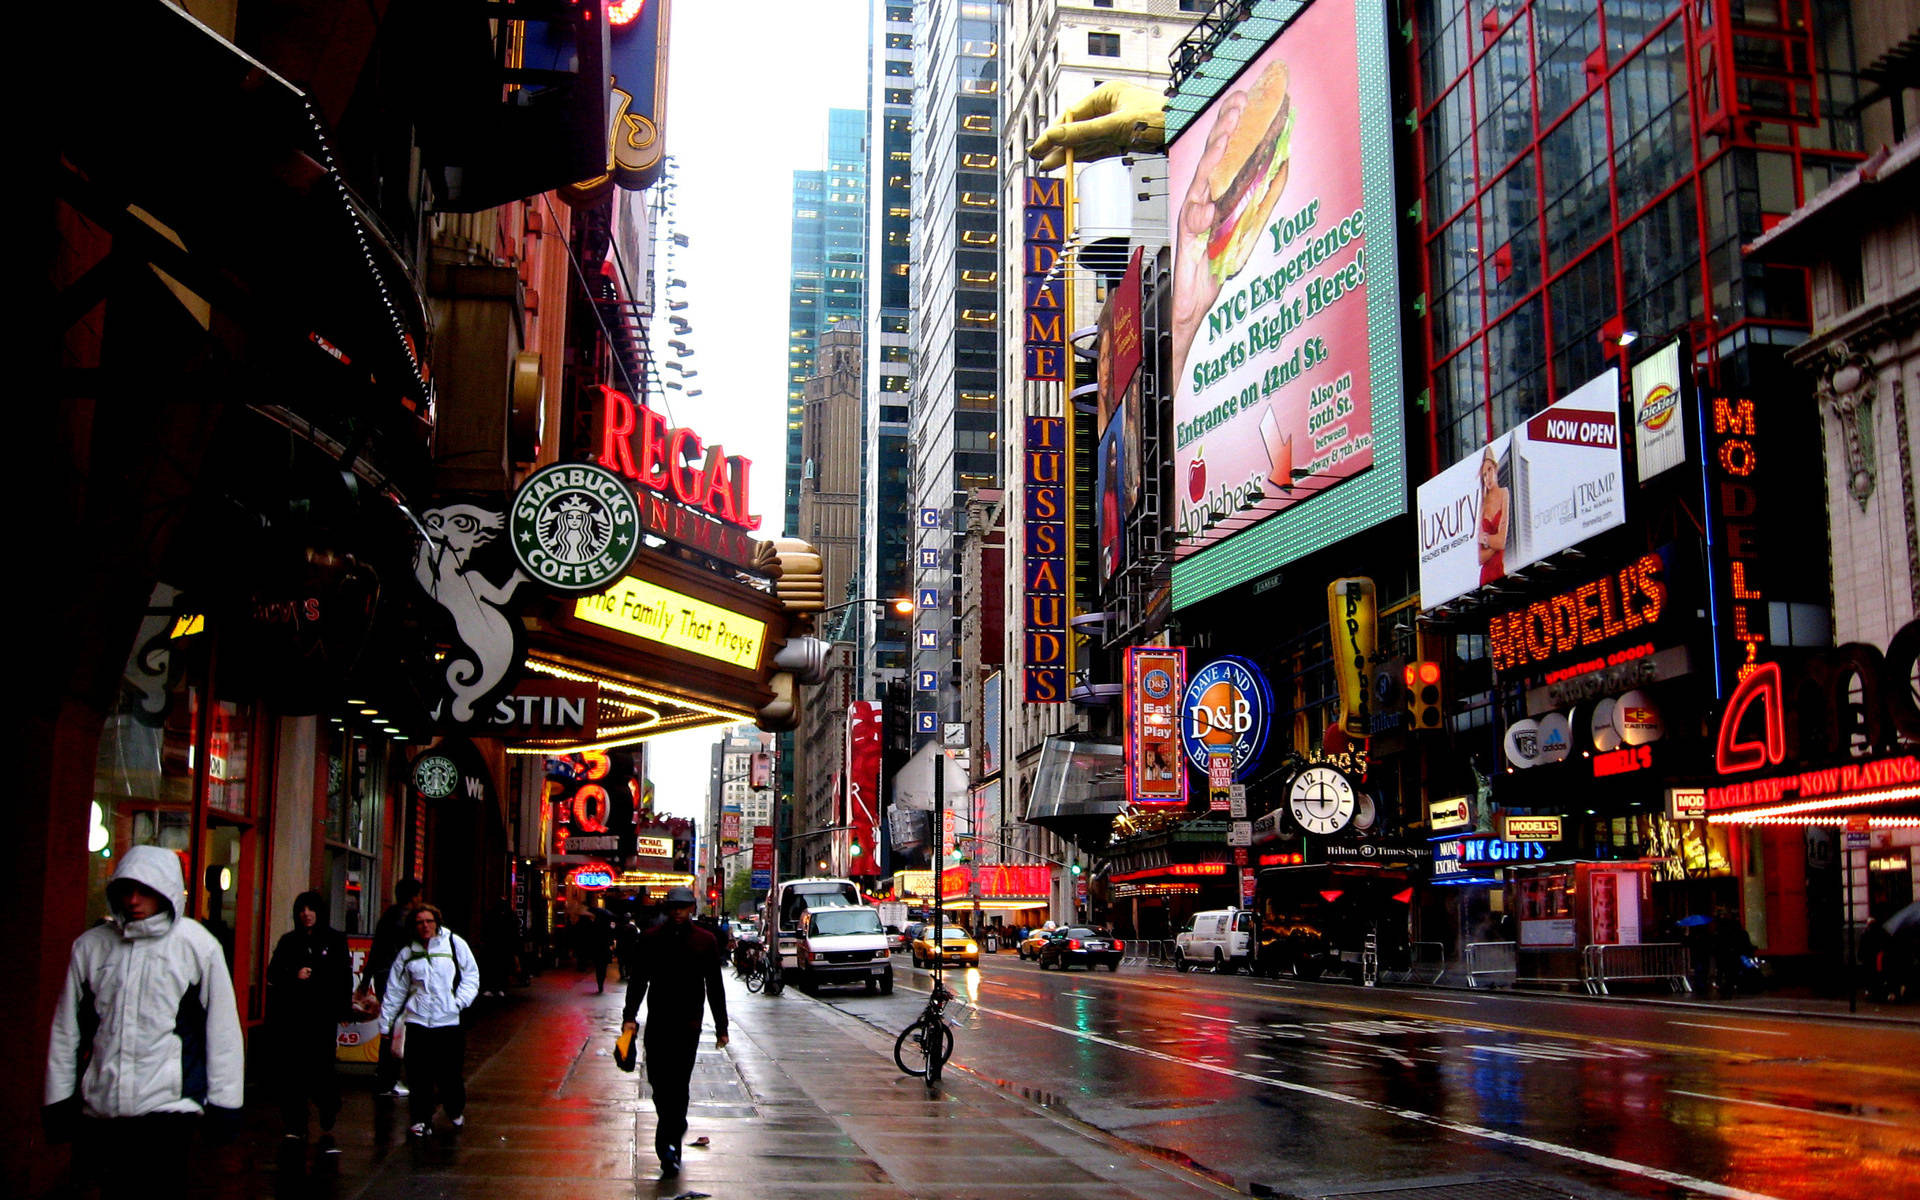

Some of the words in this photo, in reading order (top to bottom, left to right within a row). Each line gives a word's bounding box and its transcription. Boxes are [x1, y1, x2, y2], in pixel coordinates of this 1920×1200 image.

[1269, 197, 1320, 257] Your
[1028, 178, 1062, 377] MADAME
[1207, 289, 1247, 344] NYC
[1250, 208, 1366, 314] Experience
[1191, 334, 1246, 395] Starts
[1248, 301, 1303, 358] Right
[1304, 248, 1366, 318] Here!
[1176, 395, 1239, 451] Entrance
[1239, 385, 1259, 411] on
[1260, 350, 1301, 399] 42nd
[1303, 335, 1329, 371] St.
[1308, 384, 1334, 411] Also
[1334, 374, 1352, 396] on
[1641, 394, 1677, 419] Dickies
[1307, 406, 1334, 435] 50th
[1335, 395, 1354, 422] St.
[1315, 426, 1347, 450] between
[1546, 418, 1578, 441] NOW
[1579, 421, 1615, 446] OPEN
[598, 383, 763, 532] REGAL
[1307, 454, 1330, 475] dway
[1331, 447, 1340, 463] &
[1339, 443, 1354, 460] 7th
[1354, 434, 1372, 452] Ave.
[518, 468, 633, 526] STARBUCKS
[1577, 471, 1616, 507] TRUMP
[1178, 472, 1266, 545] Applebee's
[1420, 487, 1480, 553] luxury
[636, 489, 749, 564] INEMAS
[526, 547, 619, 584] COFFEE
[1031, 418, 1062, 700] TUSSAUD'S
[620, 591, 675, 639] Family
[680, 608, 714, 643] That
[718, 621, 755, 656] Preys
[921, 511, 937, 729] CHAMPS
[1488, 553, 1663, 671] MODELL'S
[1544, 656, 1607, 686] SPORTING
[1606, 641, 1656, 667] GOODS
[1147, 679, 1169, 689] D&B
[1189, 666, 1219, 700] DAVE
[1222, 665, 1250, 692] AND
[1143, 703, 1172, 714] Eat
[1189, 698, 1253, 739] D&B
[1636, 710, 1645, 720] E
[1143, 726, 1172, 739] Play
[1624, 722, 1659, 731] EASTON
[1192, 740, 1251, 769] BUR'S
[1212, 757, 1229, 769] NEW
[1543, 742, 1568, 752] adidas
[418, 757, 457, 777] STARBUCKS
[1303, 772, 1316, 786] 12
[420, 784, 452, 798] COFFEE
[1340, 782, 1350, 793] 3
[1678, 795, 1705, 809] MOD
[1708, 783, 1753, 809] EAGLE
[1798, 767, 1840, 798] NOW
[1294, 809, 1304, 820] 9
[1330, 818, 1340, 829] 6
[1510, 821, 1558, 832] MODELL'S
[1327, 846, 1358, 855] Hilton
[1377, 846, 1406, 856] Times
[1406, 848, 1433, 858] Squar
[1440, 840, 1458, 857] MONE
[1466, 840, 1486, 861] NY
[577, 873, 612, 886] BBQ
